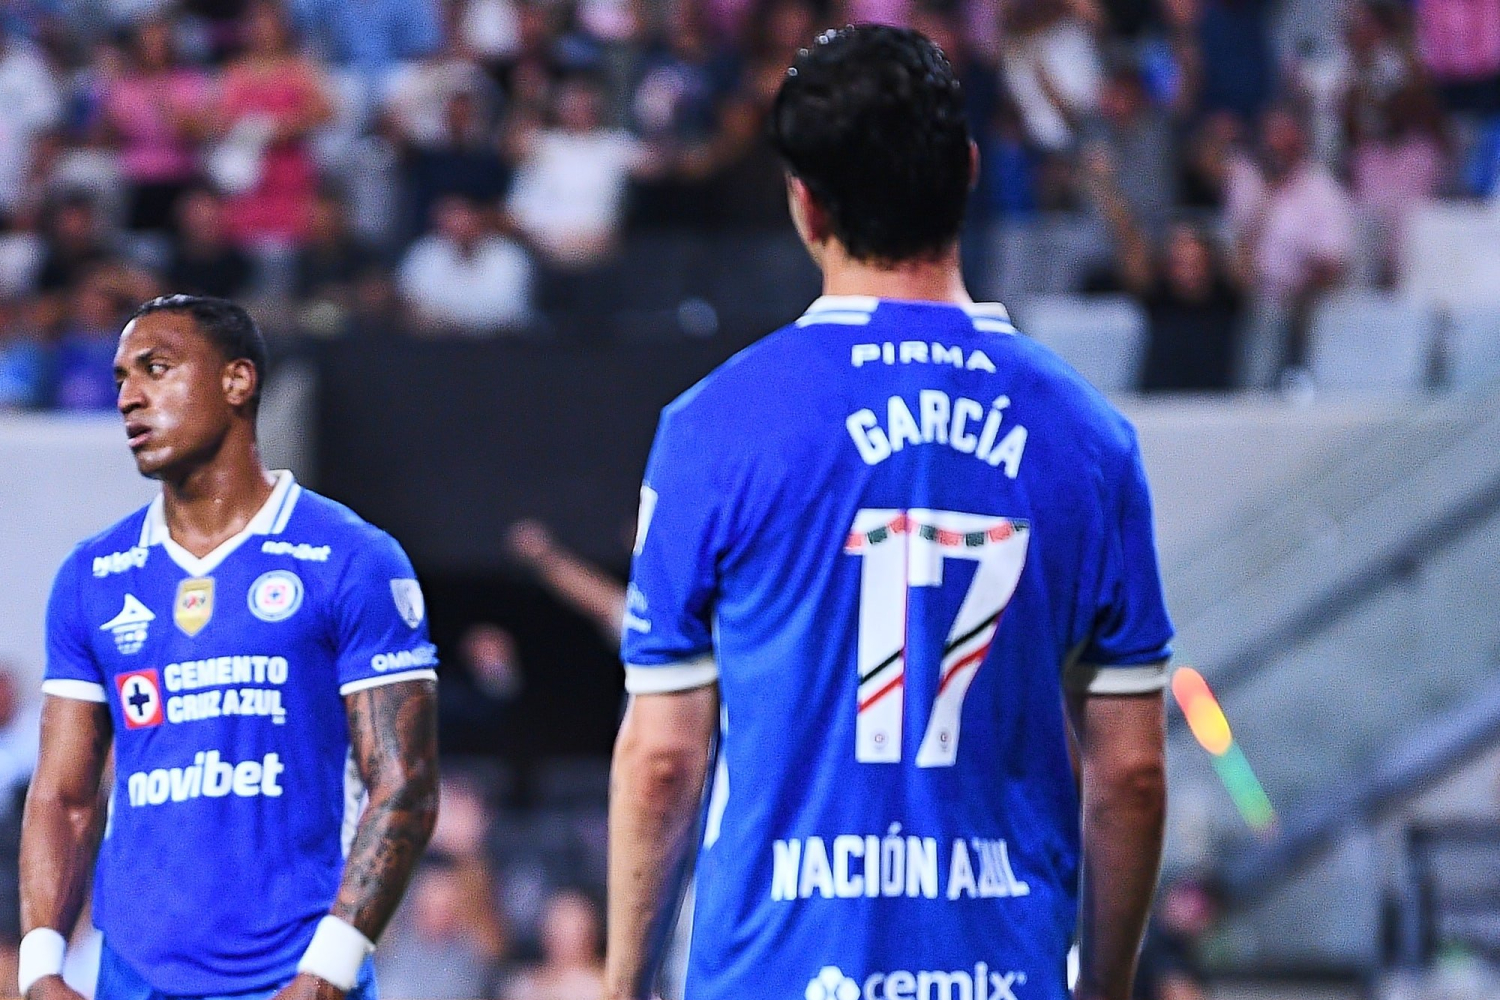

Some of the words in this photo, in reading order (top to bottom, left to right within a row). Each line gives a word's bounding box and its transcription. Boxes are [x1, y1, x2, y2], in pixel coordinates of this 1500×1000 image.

[851, 340, 997, 374] PIRMA
[846, 389, 1029, 479] GARCÍA
[844, 508, 1030, 769] 17
[163, 655, 289, 693] CEMENTO
[166, 689, 222, 724] CRUZ
[222, 688, 287, 717] AZUL
[128, 749, 285, 807] novibet
[771, 821, 937, 902] NACIÓN
